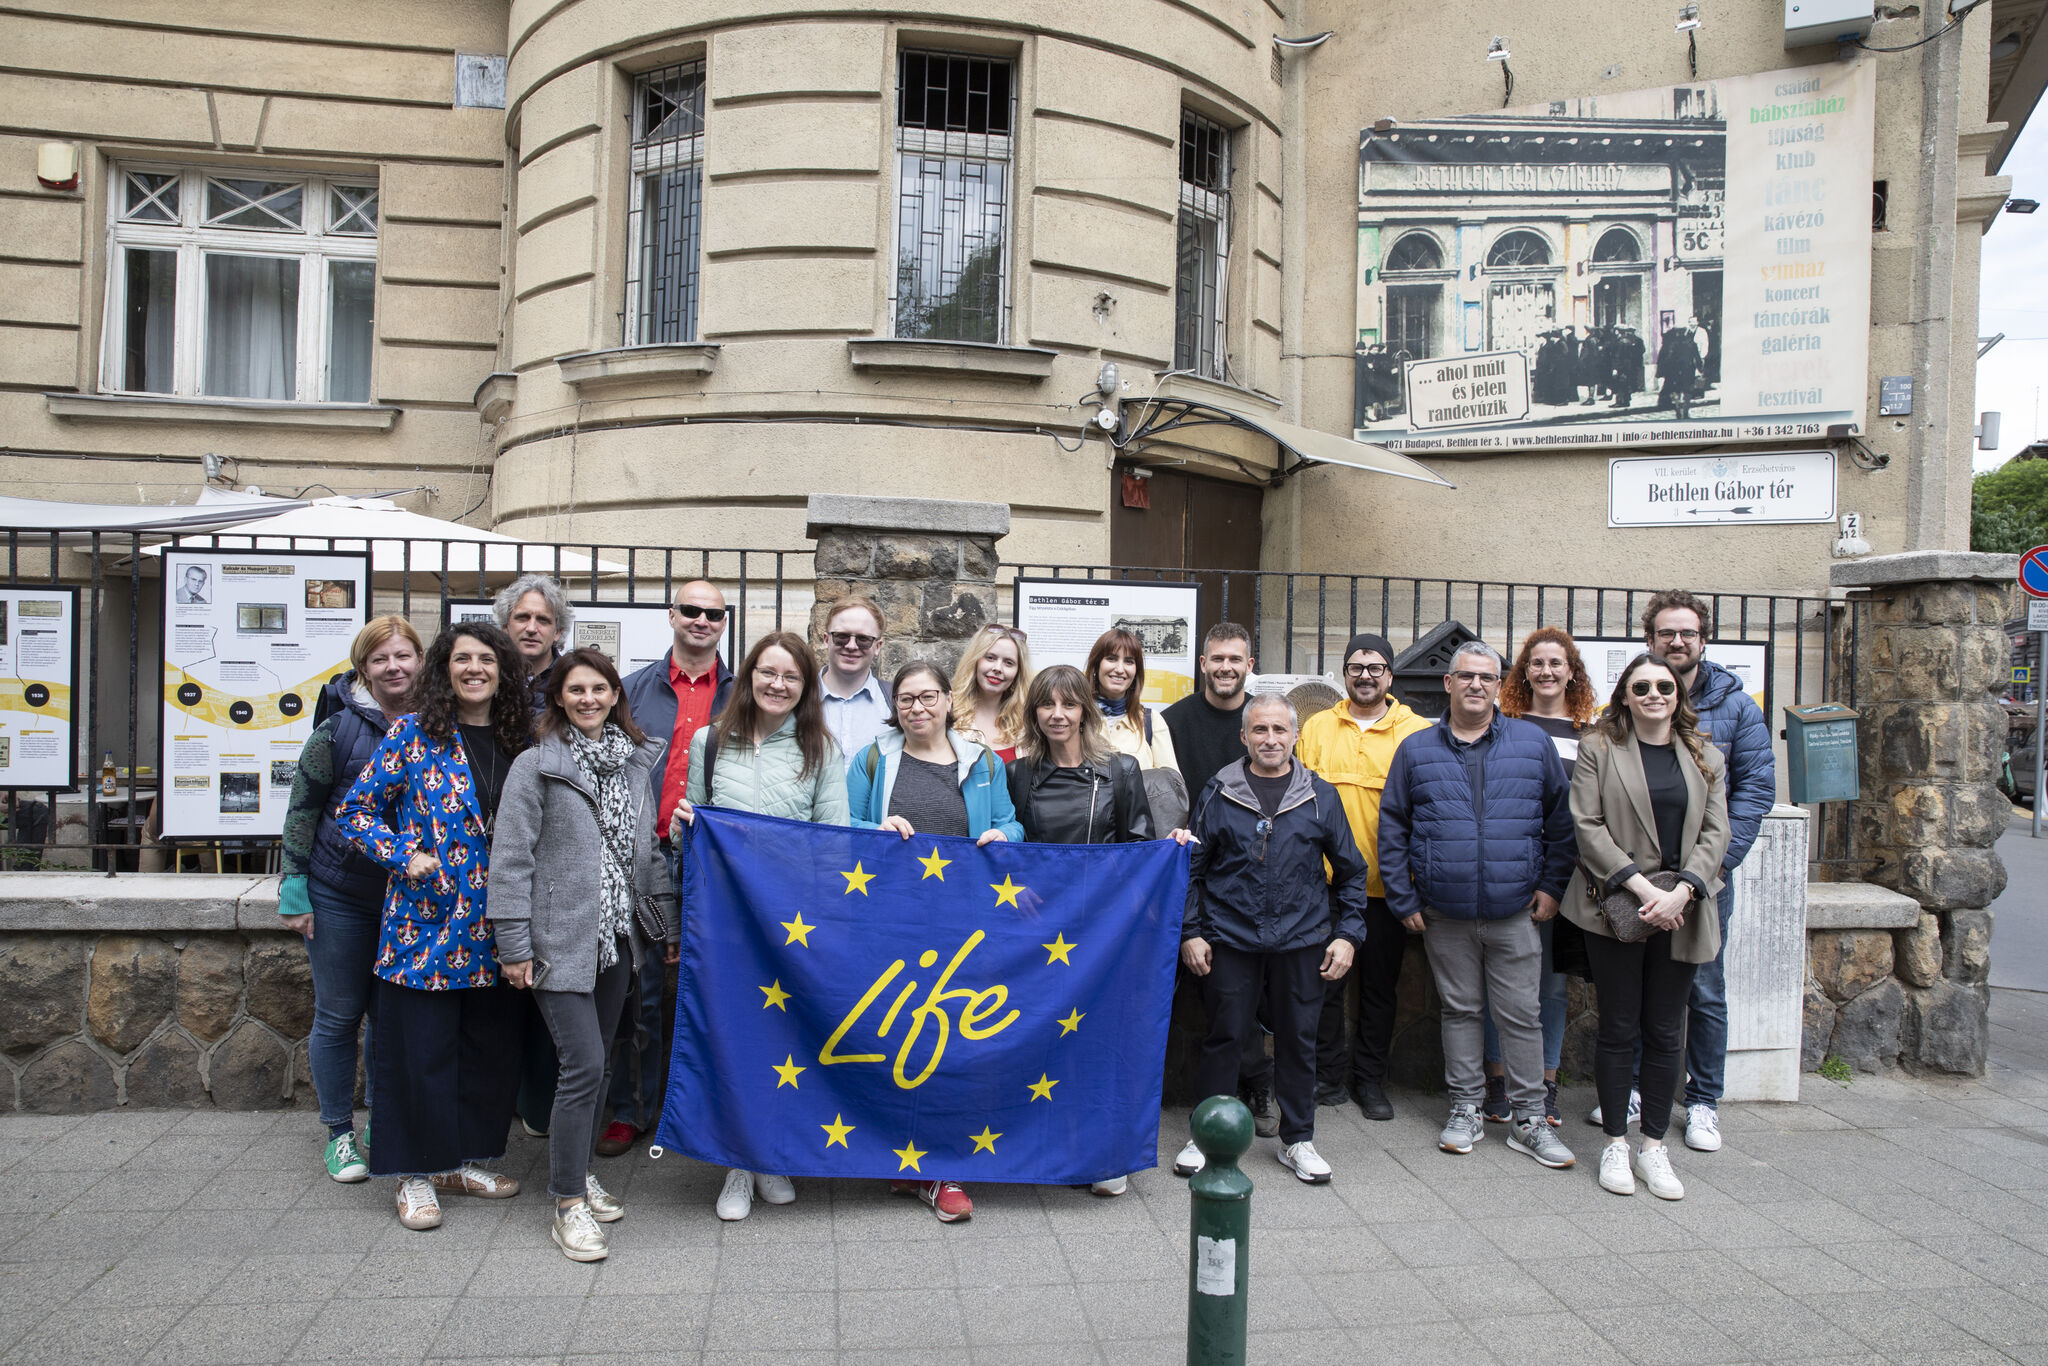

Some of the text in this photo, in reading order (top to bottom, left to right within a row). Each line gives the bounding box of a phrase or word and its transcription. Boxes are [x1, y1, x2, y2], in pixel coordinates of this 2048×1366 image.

[1776, 150, 1816, 171] klub
[1764, 209, 1825, 232] kávézó
[1776, 237, 1811, 255] film
[1765, 285, 1821, 303] koncert
[1753, 307, 1831, 329] táncórák
[1761, 333, 1822, 356] galéria
[1436, 364, 1468, 383] ahol
[1472, 359, 1506, 378] múlt
[1452, 381, 1507, 400] és jelen
[1757, 388, 1823, 408] fesztivál
[1428, 399, 1508, 423] randevúzik
[1404, 438, 1445, 450] Budapest,
[1446, 437, 1479, 448] Bethlen
[1480, 436, 1493, 447] tér
[1494, 437, 1503, 447] 3.
[1744, 425, 1764, 437] +36
[1774, 424, 1793, 435] 342
[1796, 423, 1820, 434] 7163
[1654, 463, 1796, 477] VII. kerület Erzsébetváros
[1648, 478, 1794, 503] Bethlen Gábor tér
[1847, 517, 1857, 528] Z
[1029, 596, 1058, 604] Bethlen
[1061, 597, 1081, 605] Gábor
[818, 929, 1021, 1090] Life
